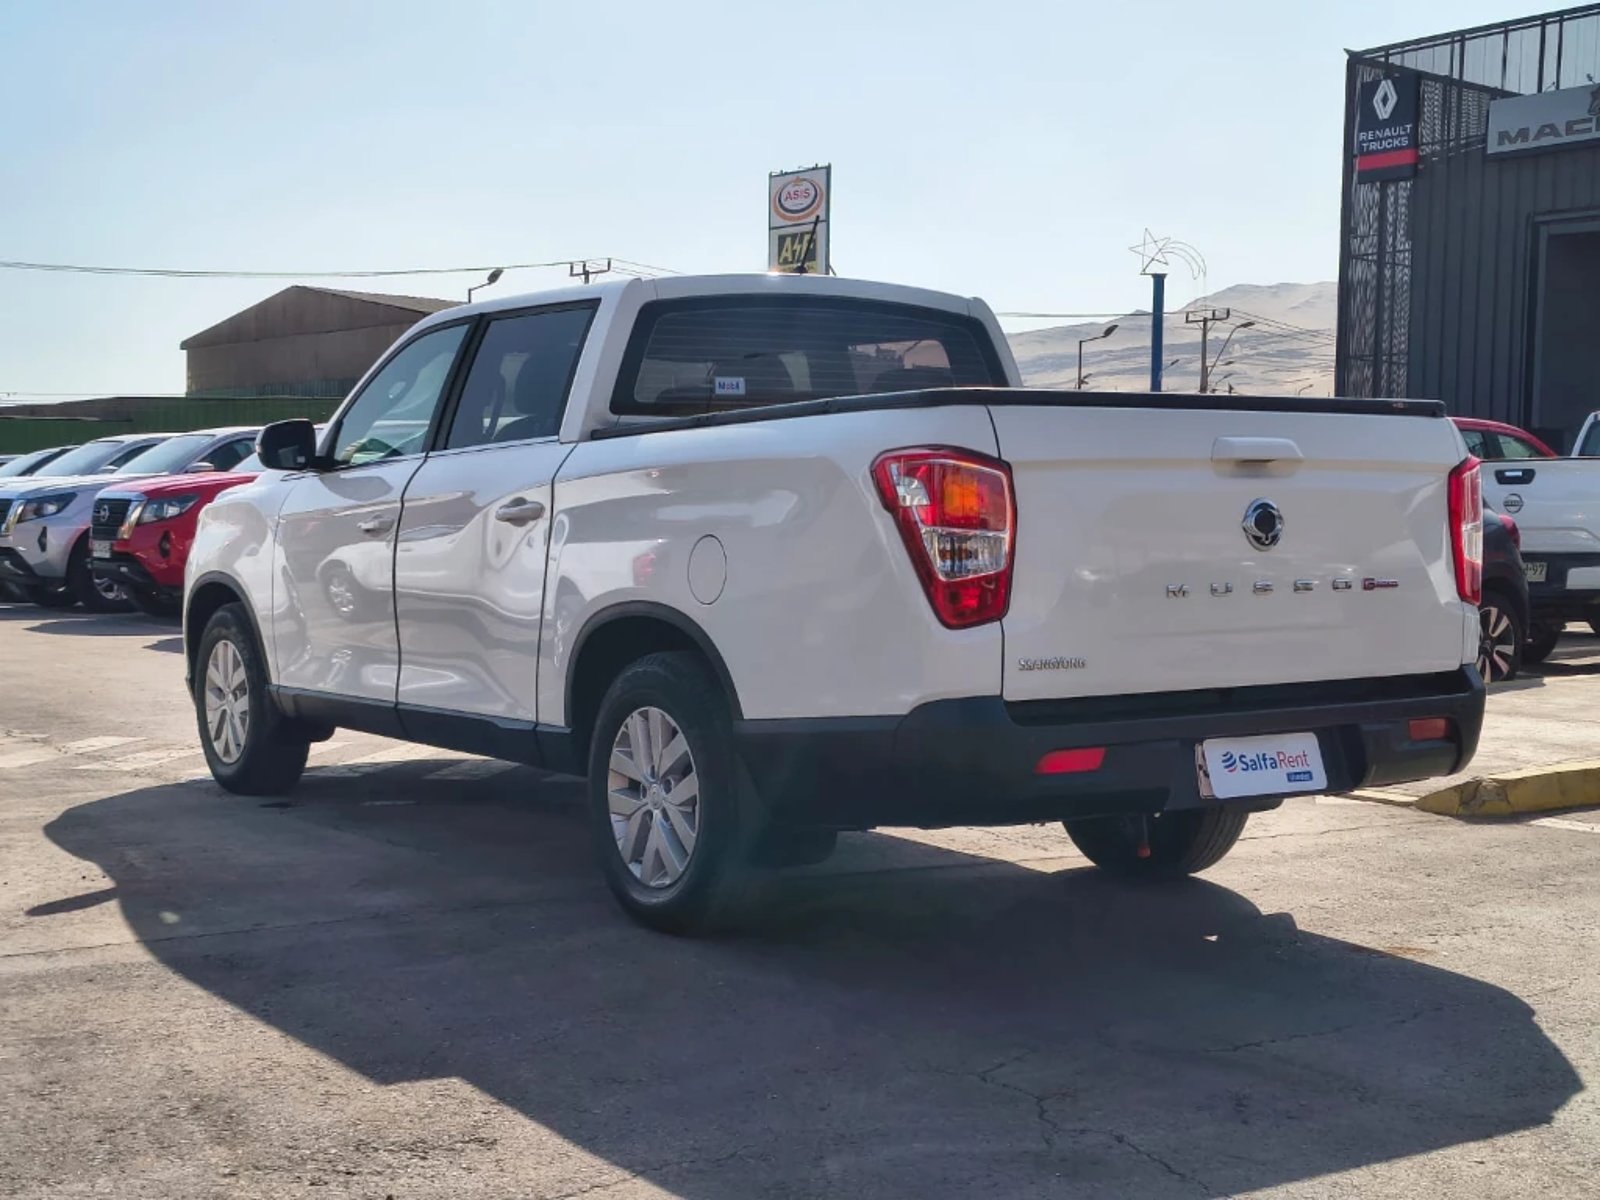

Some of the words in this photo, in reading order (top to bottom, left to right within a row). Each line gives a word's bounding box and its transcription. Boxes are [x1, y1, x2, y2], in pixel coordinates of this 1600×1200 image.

[1360, 124, 1412, 141] RENAULT
[1362, 136, 1409, 152] TRUCKS
[1238, 749, 1311, 772] SalfaRent
